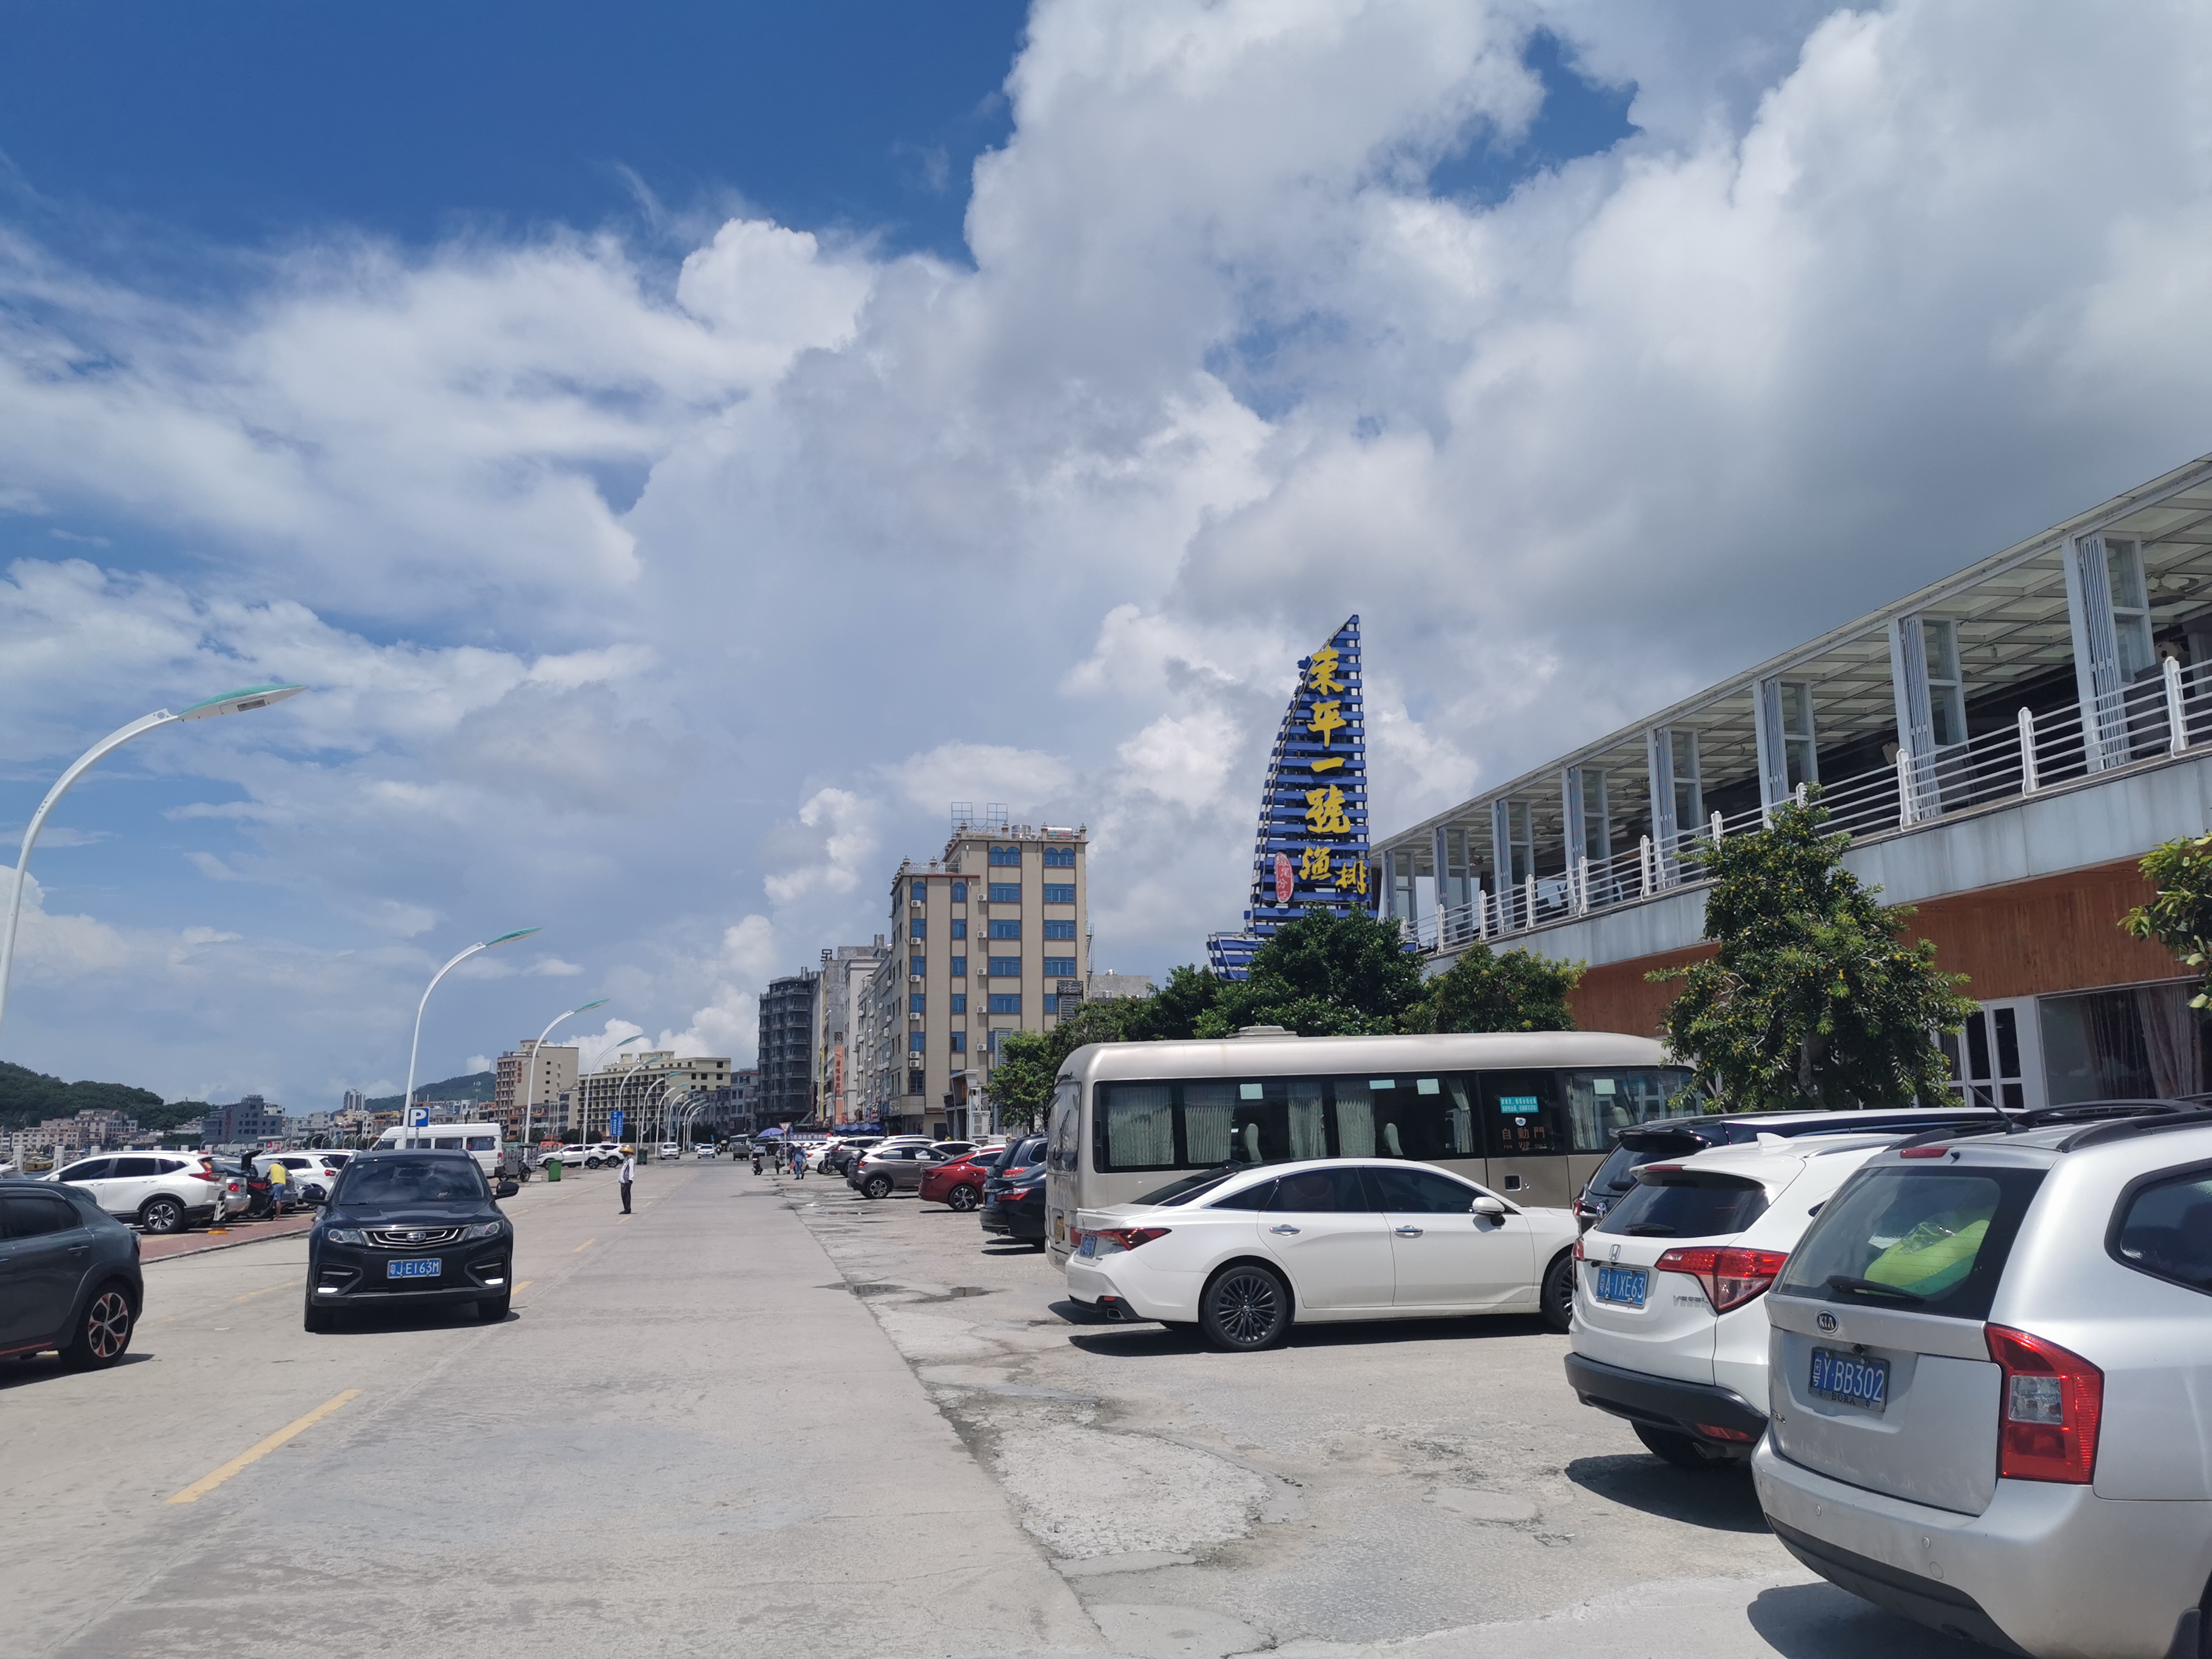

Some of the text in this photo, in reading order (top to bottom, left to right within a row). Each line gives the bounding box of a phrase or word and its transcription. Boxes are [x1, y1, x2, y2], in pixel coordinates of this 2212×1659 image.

[410, 1109, 427, 1127] P
[1502, 1127, 1546, 1140] 自動門
[1819, 1315, 1835, 1330] KIA
[1831, 1392, 1857, 1406] BORA
